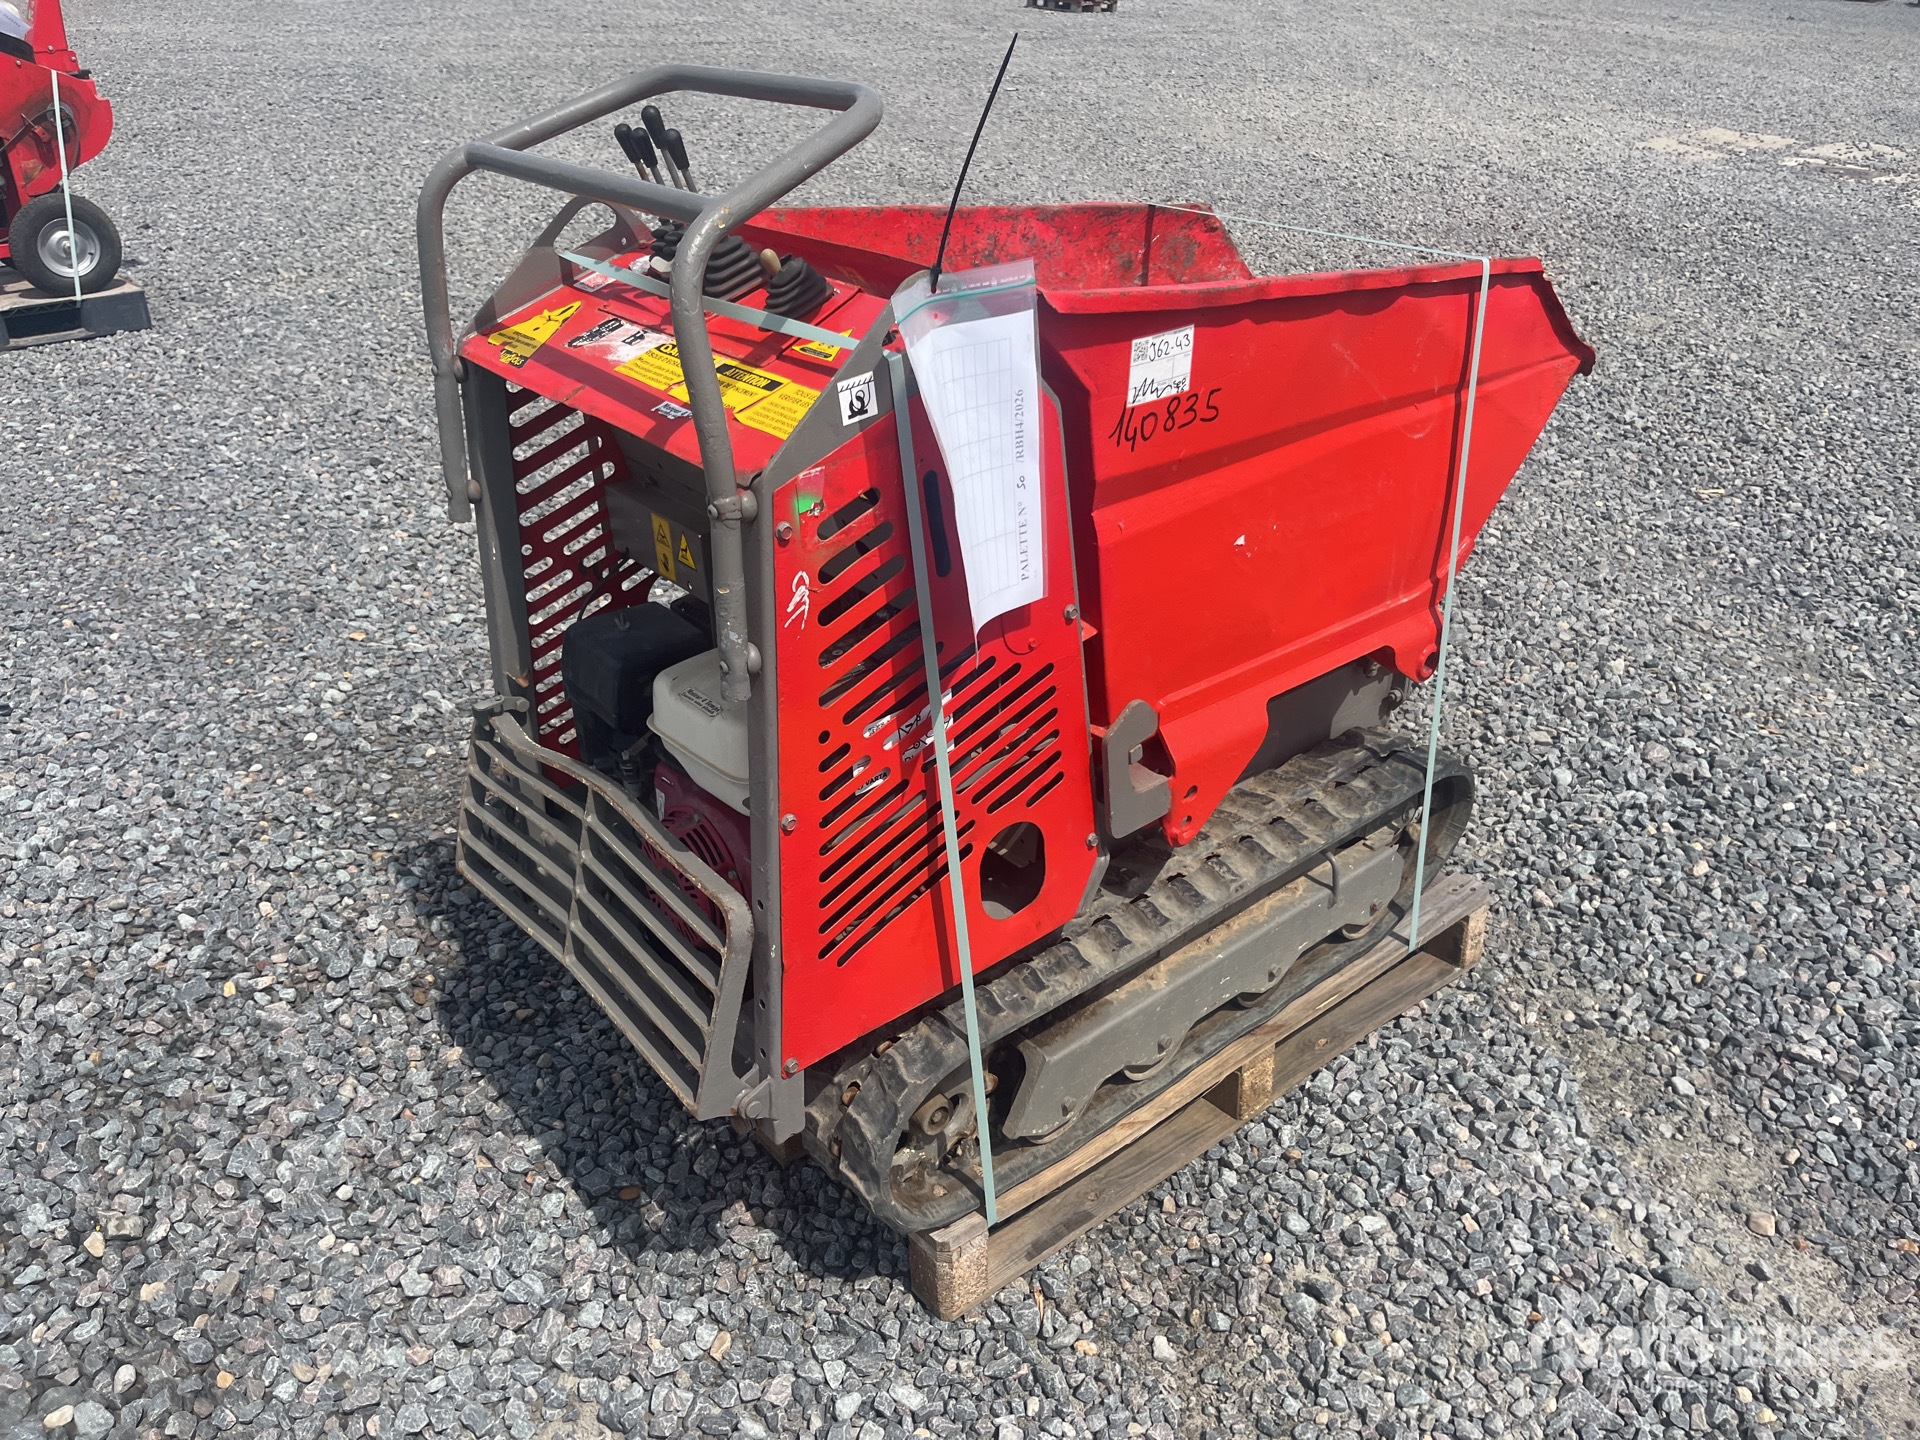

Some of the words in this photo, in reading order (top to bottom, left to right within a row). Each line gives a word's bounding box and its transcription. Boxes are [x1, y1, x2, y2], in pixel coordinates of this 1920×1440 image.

[723, 367, 772, 389] ATTENTION
[1108, 388, 1222, 453] 140835
[1018, 519, 1030, 581] PALETTE
[865, 770, 888, 786] VARTA
